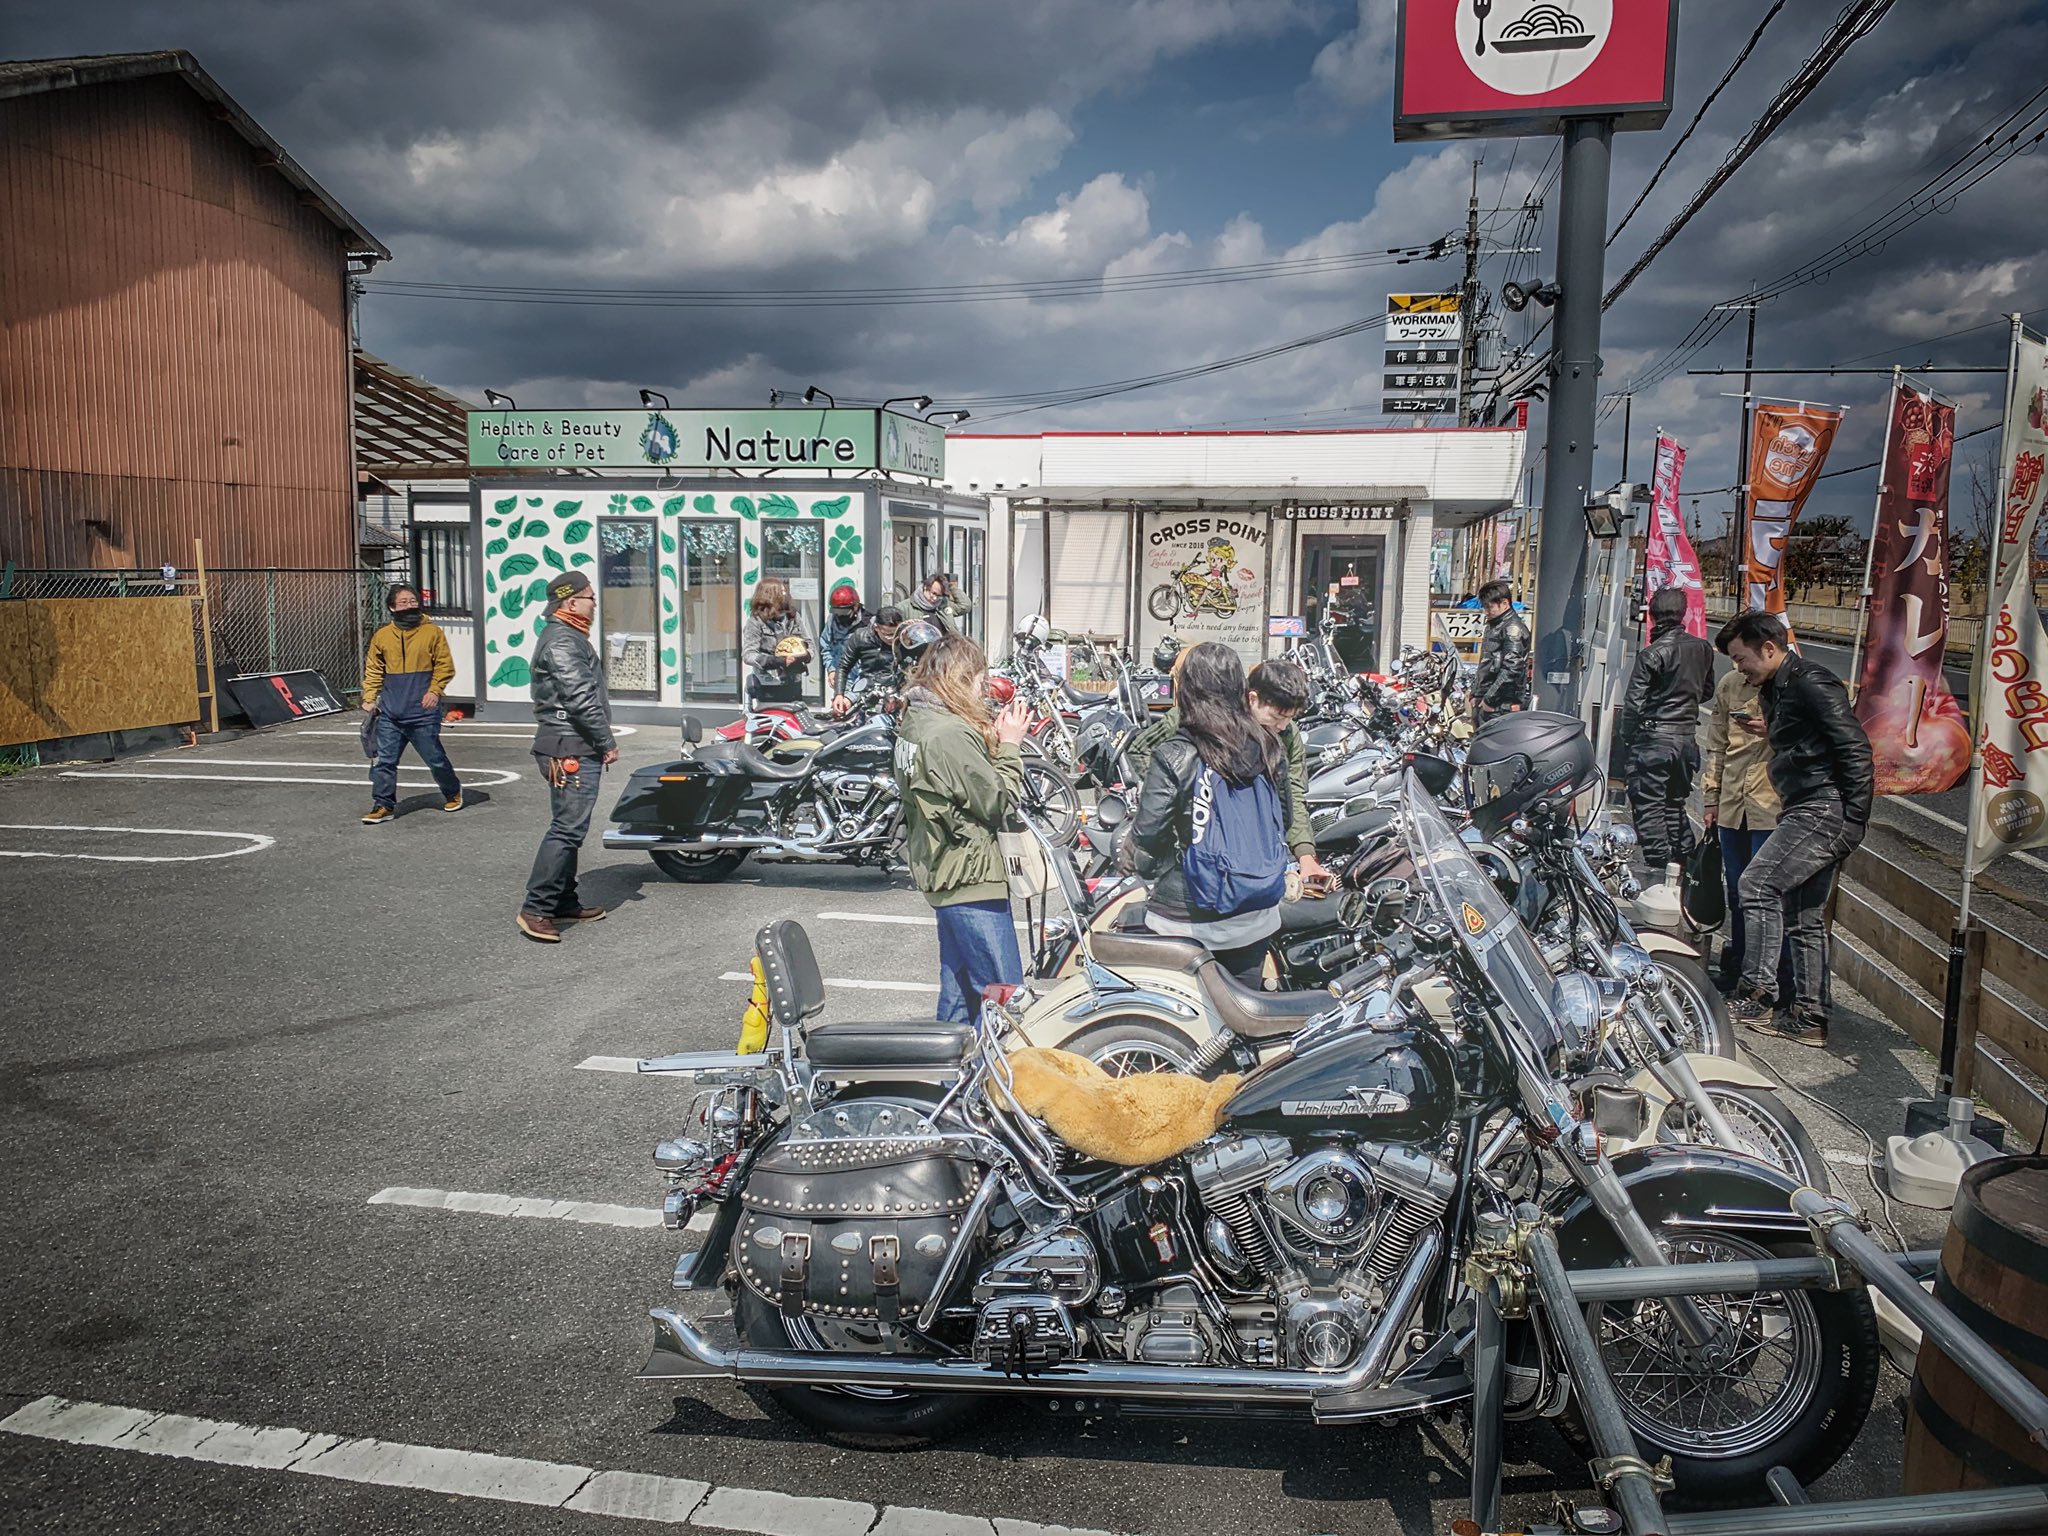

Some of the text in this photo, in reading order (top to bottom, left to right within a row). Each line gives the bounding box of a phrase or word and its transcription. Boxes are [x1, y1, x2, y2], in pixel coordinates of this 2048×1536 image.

[1392, 315, 1455, 326] WORKMAN
[1399, 328, 1447, 339] ワークマン
[1396, 351, 1448, 363] 作業服
[1393, 400, 1446, 411] ユニフォーム
[480, 419, 622, 440] Health & Beauty
[497, 442, 606, 461] Care of Pet
[705, 427, 856, 464] Nature
[904, 442, 939, 474] Nature
[1150, 518, 1211, 546] CROSS
[1206, 622, 1222, 631] need
[1223, 624, 1237, 633] any
[1238, 623, 1260, 632] brains
[1894, 507, 1946, 749] カレー
[1546, 763, 1572, 783] SHOEI
[1841, 1344, 1851, 1378] AVON
